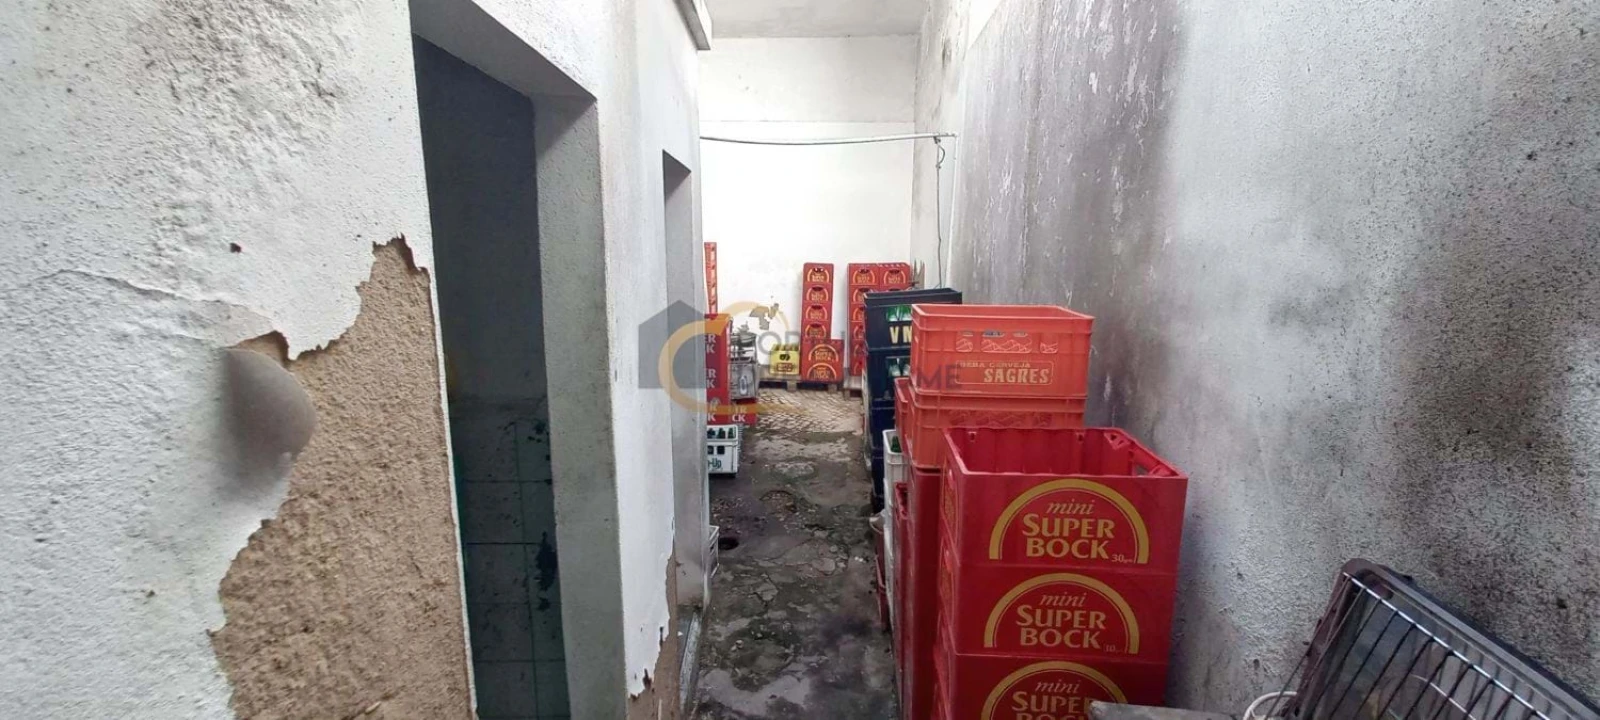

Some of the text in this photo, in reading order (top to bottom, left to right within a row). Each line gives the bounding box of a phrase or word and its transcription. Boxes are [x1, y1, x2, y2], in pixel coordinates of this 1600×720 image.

[983, 368, 1050, 384] SAGRES
[1046, 498, 1095, 515] mini
[1022, 513, 1116, 539] SUPER
[1026, 537, 1109, 559] BOCK
[1040, 591, 1087, 608] mini
[1016, 604, 1107, 630] SUPER
[1020, 627, 1101, 649] BOCK
[1034, 679, 1081, 695] mini
